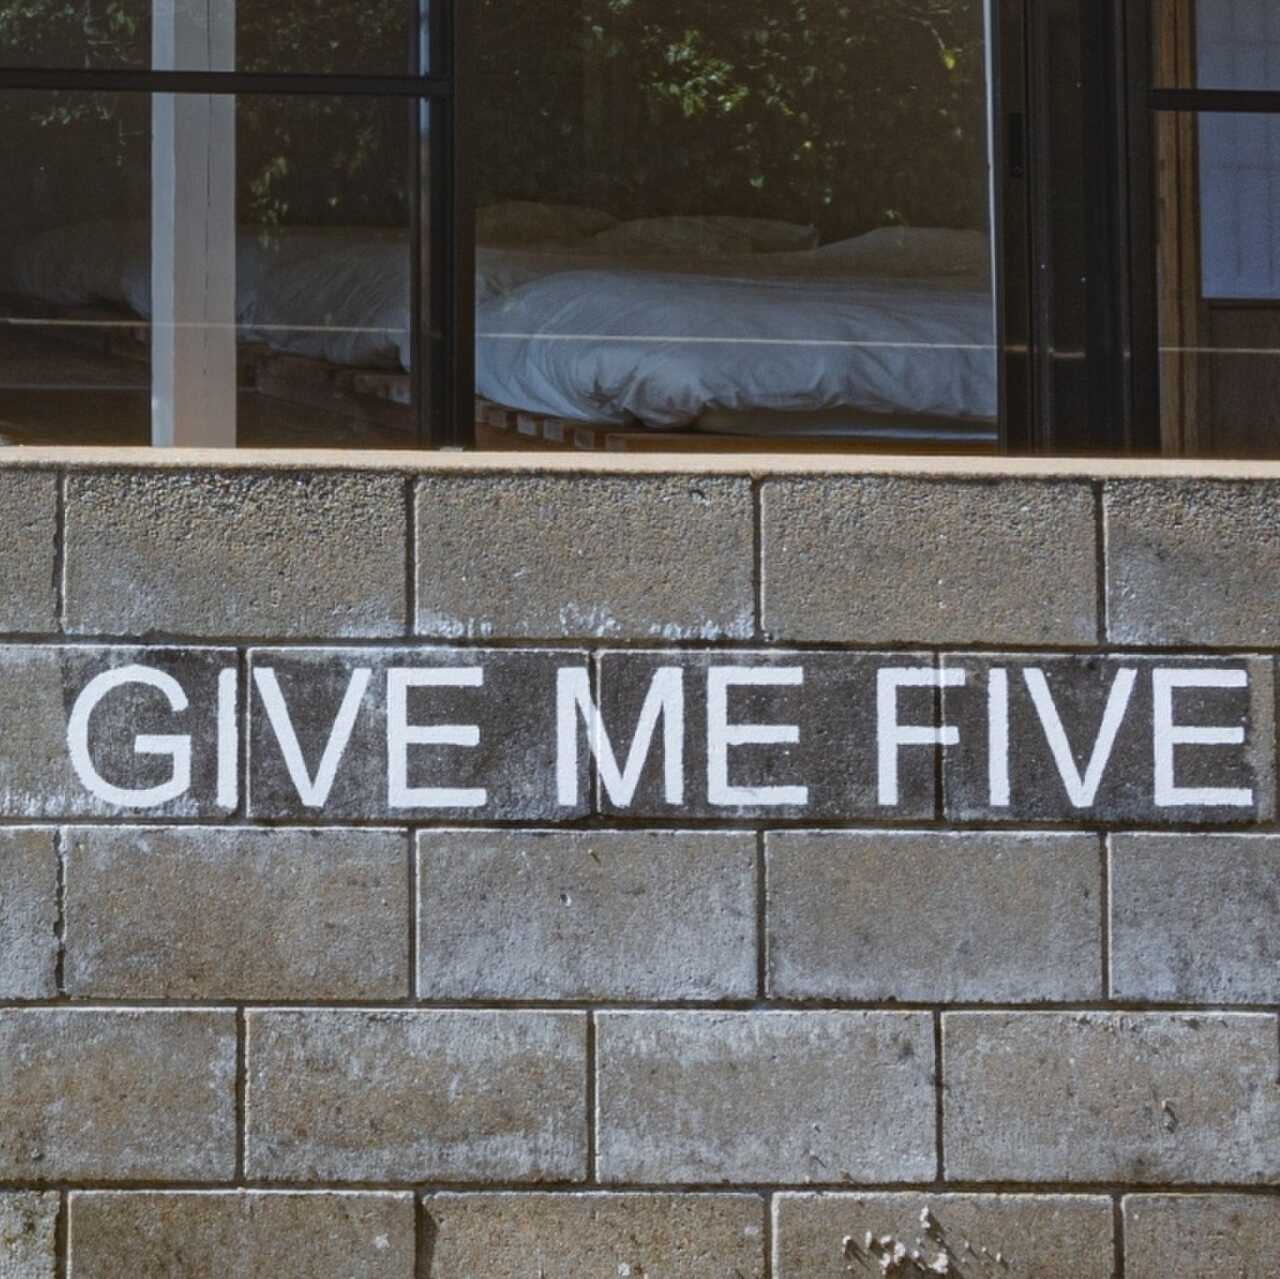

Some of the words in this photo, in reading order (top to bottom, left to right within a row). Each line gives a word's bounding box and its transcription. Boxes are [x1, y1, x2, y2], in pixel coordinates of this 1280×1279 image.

[66, 664, 487, 809] GIVE
[557, 666, 808, 807] ME
[877, 667, 1253, 808] FIVE
